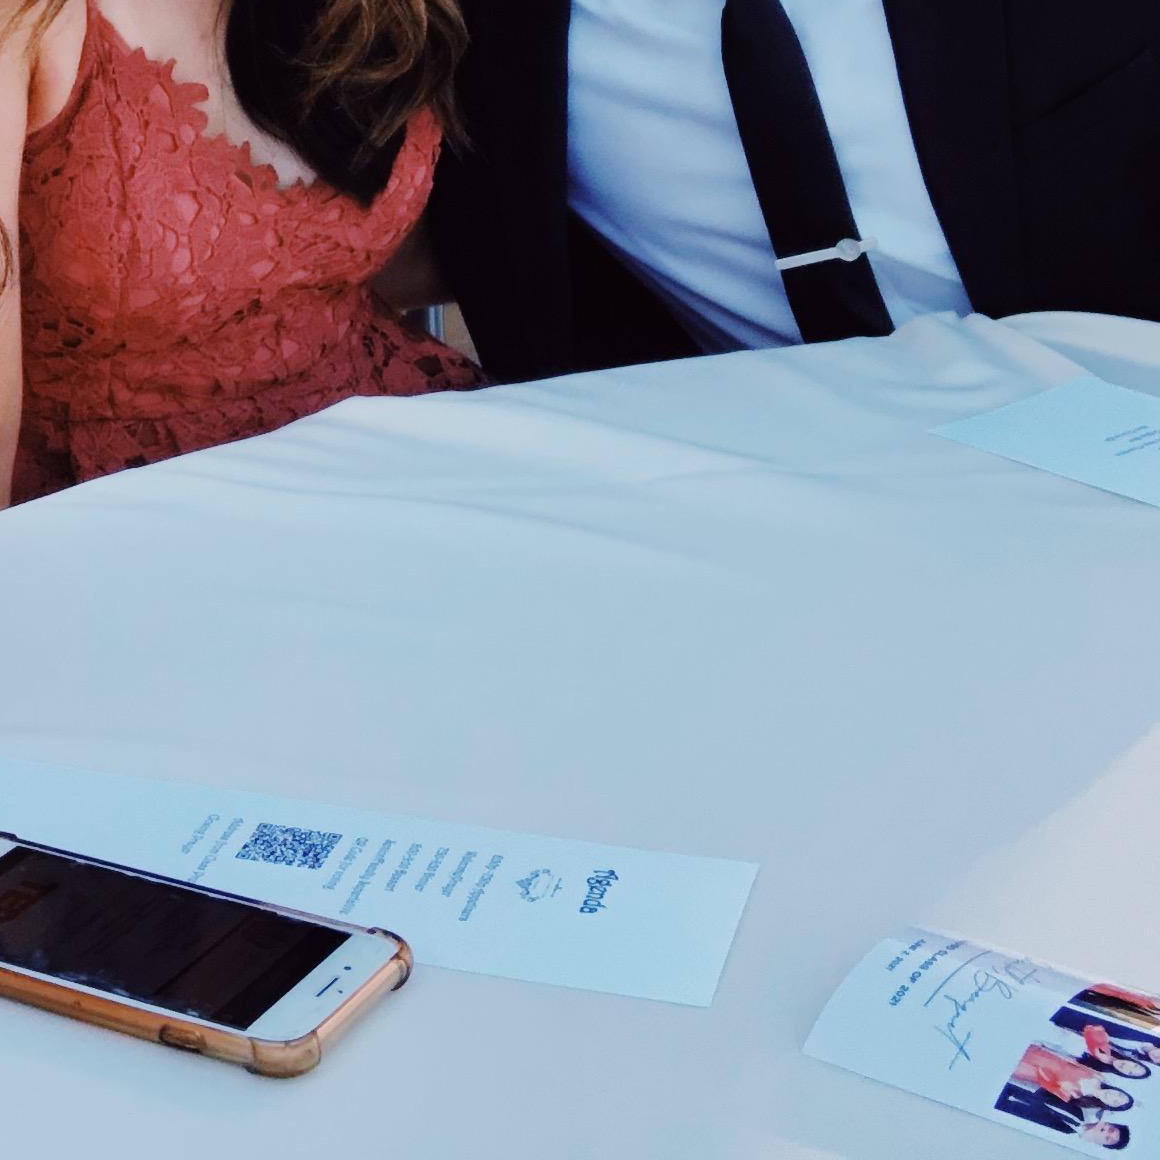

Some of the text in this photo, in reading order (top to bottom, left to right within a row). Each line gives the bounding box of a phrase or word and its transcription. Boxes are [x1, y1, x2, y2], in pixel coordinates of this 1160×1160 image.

[889, 950, 948, 1007] CLASS OF 2021
